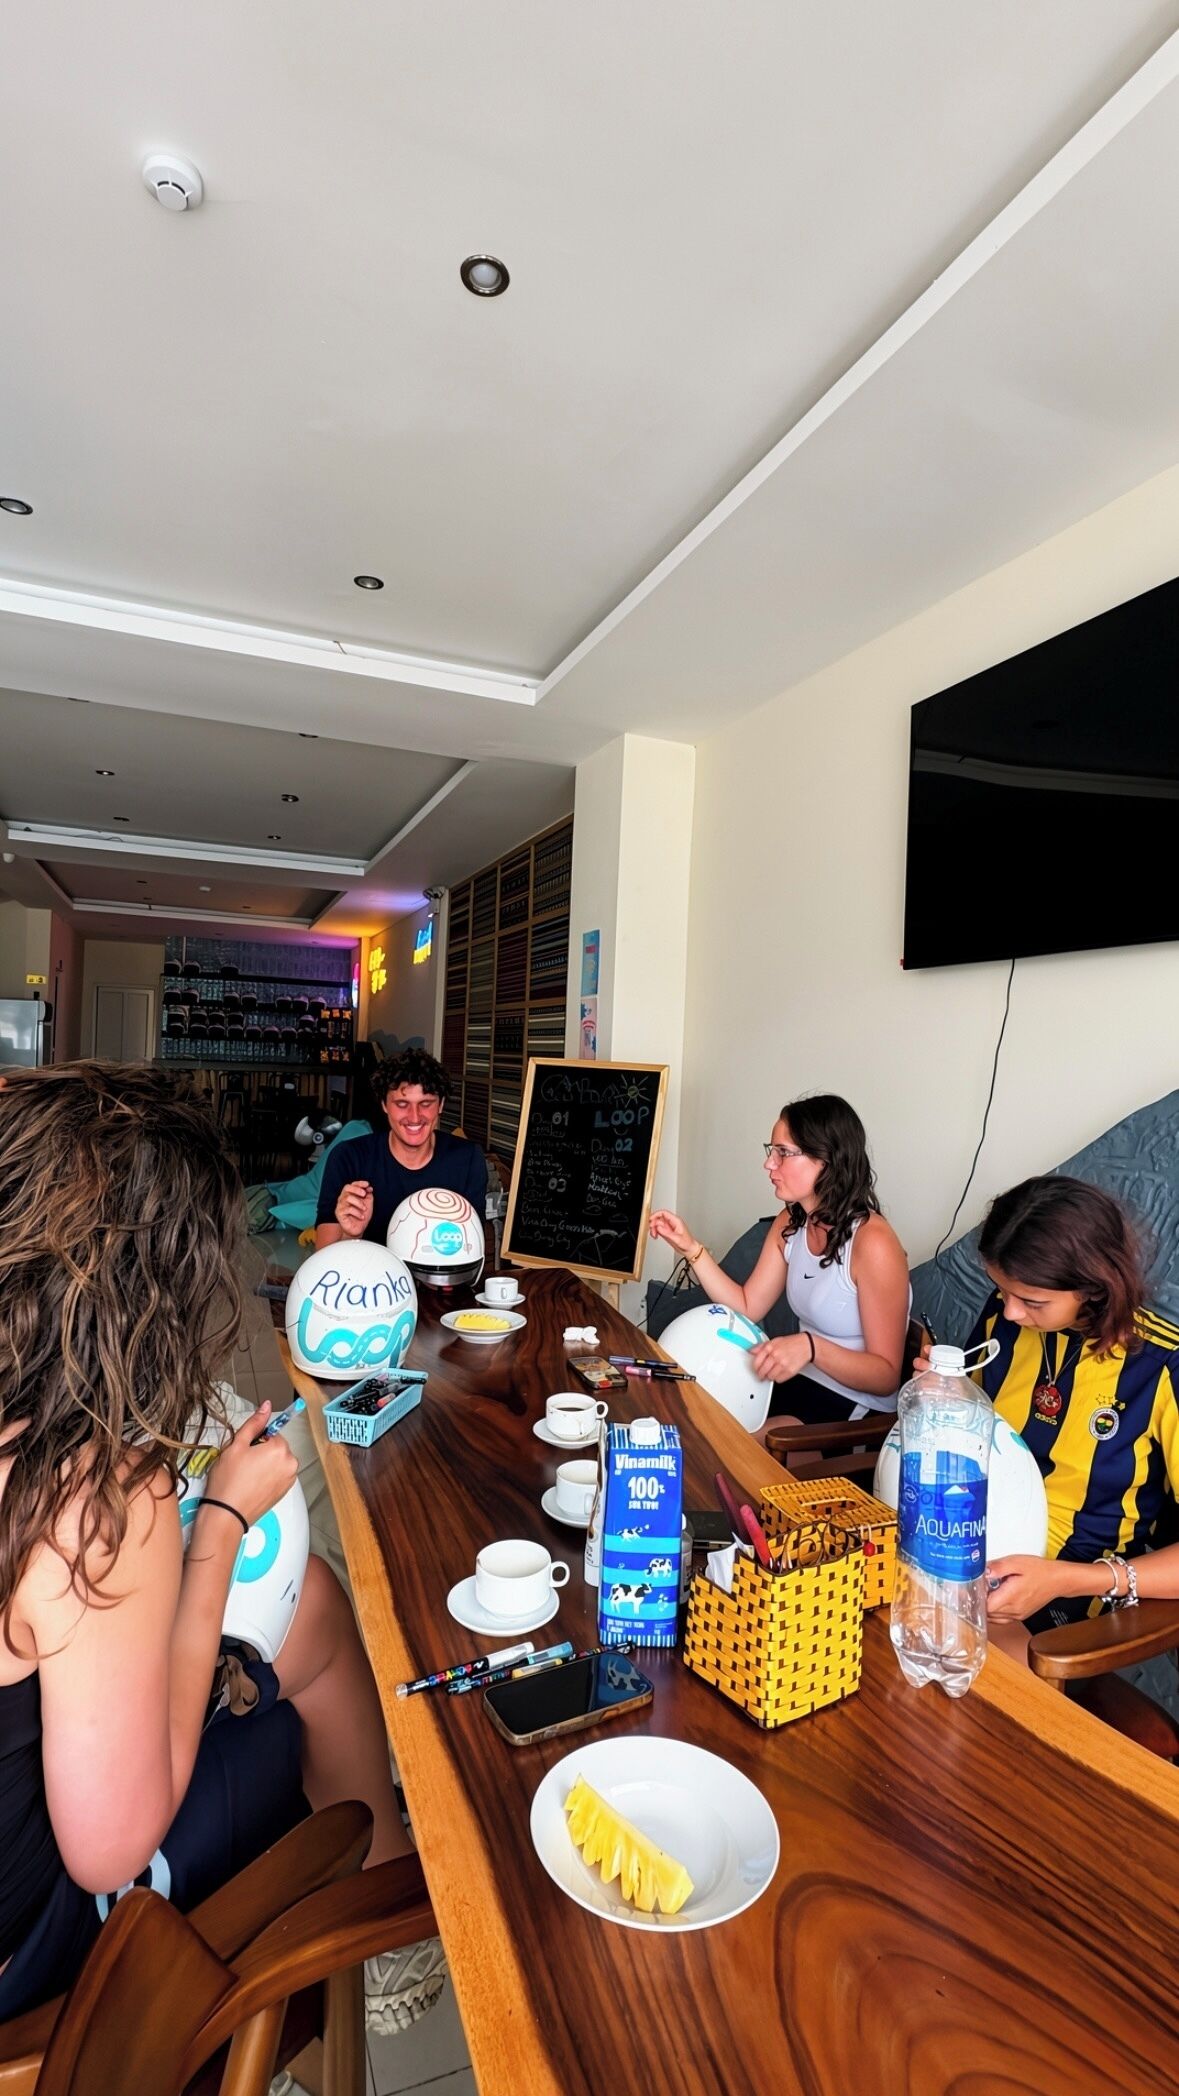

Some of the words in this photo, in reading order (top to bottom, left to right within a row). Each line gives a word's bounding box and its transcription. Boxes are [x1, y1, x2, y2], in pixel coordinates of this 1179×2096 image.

[552, 1111, 570, 1126] 01
[594, 1106, 650, 1128] LOOP
[615, 1138, 633, 1152] 02
[548, 1177, 567, 1192] 03
[310, 1270, 412, 1309] Rianka
[615, 1454, 677, 1470] Vinamilk
